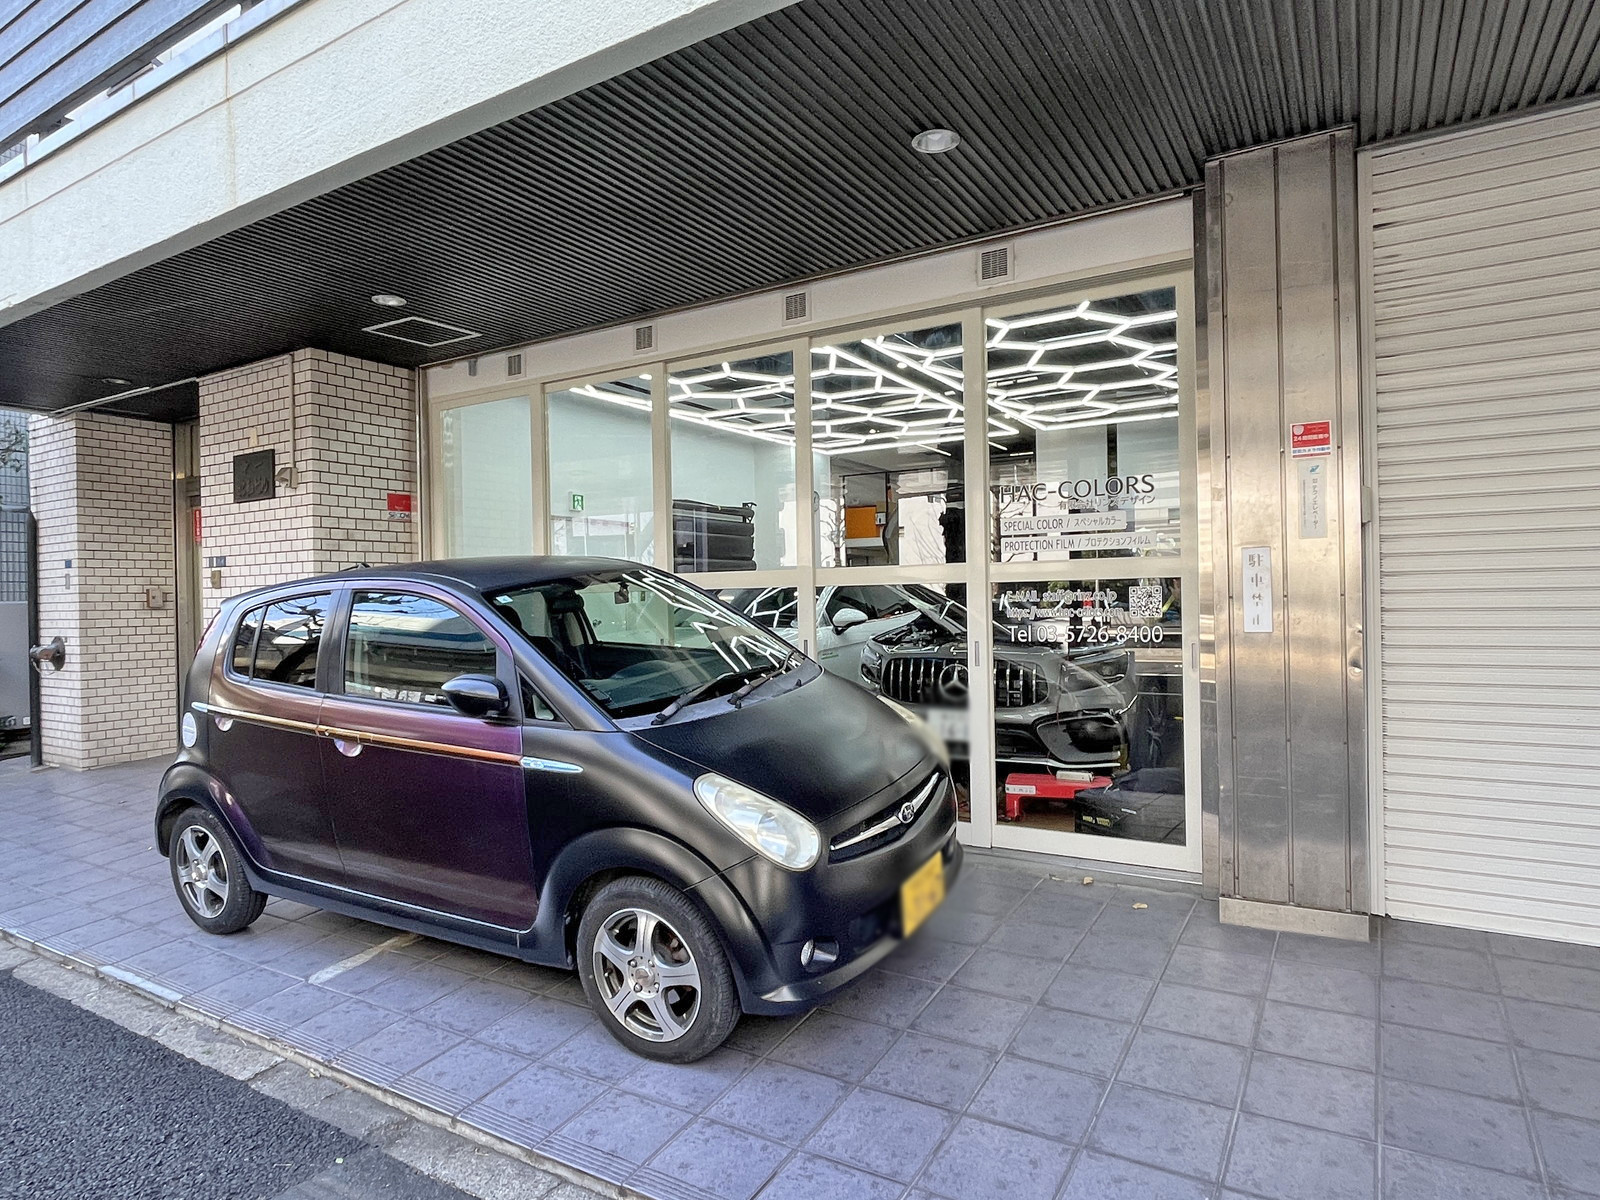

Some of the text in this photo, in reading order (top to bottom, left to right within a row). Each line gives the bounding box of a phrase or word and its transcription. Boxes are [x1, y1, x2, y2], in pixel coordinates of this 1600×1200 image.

[1000, 474, 1155, 503] HAC-COLORS
[1003, 520, 1035, 532] SPECIAL
[1036, 518, 1064, 530] COLOR
[1074, 516, 1122, 527] スペシャルカラー
[1004, 539, 1054, 552] PROTECTION
[1056, 538, 1075, 549] FILM
[1085, 535, 1151, 548] プロテクションフィルム
[1007, 625, 1164, 643] Tel 03-5726-8400
